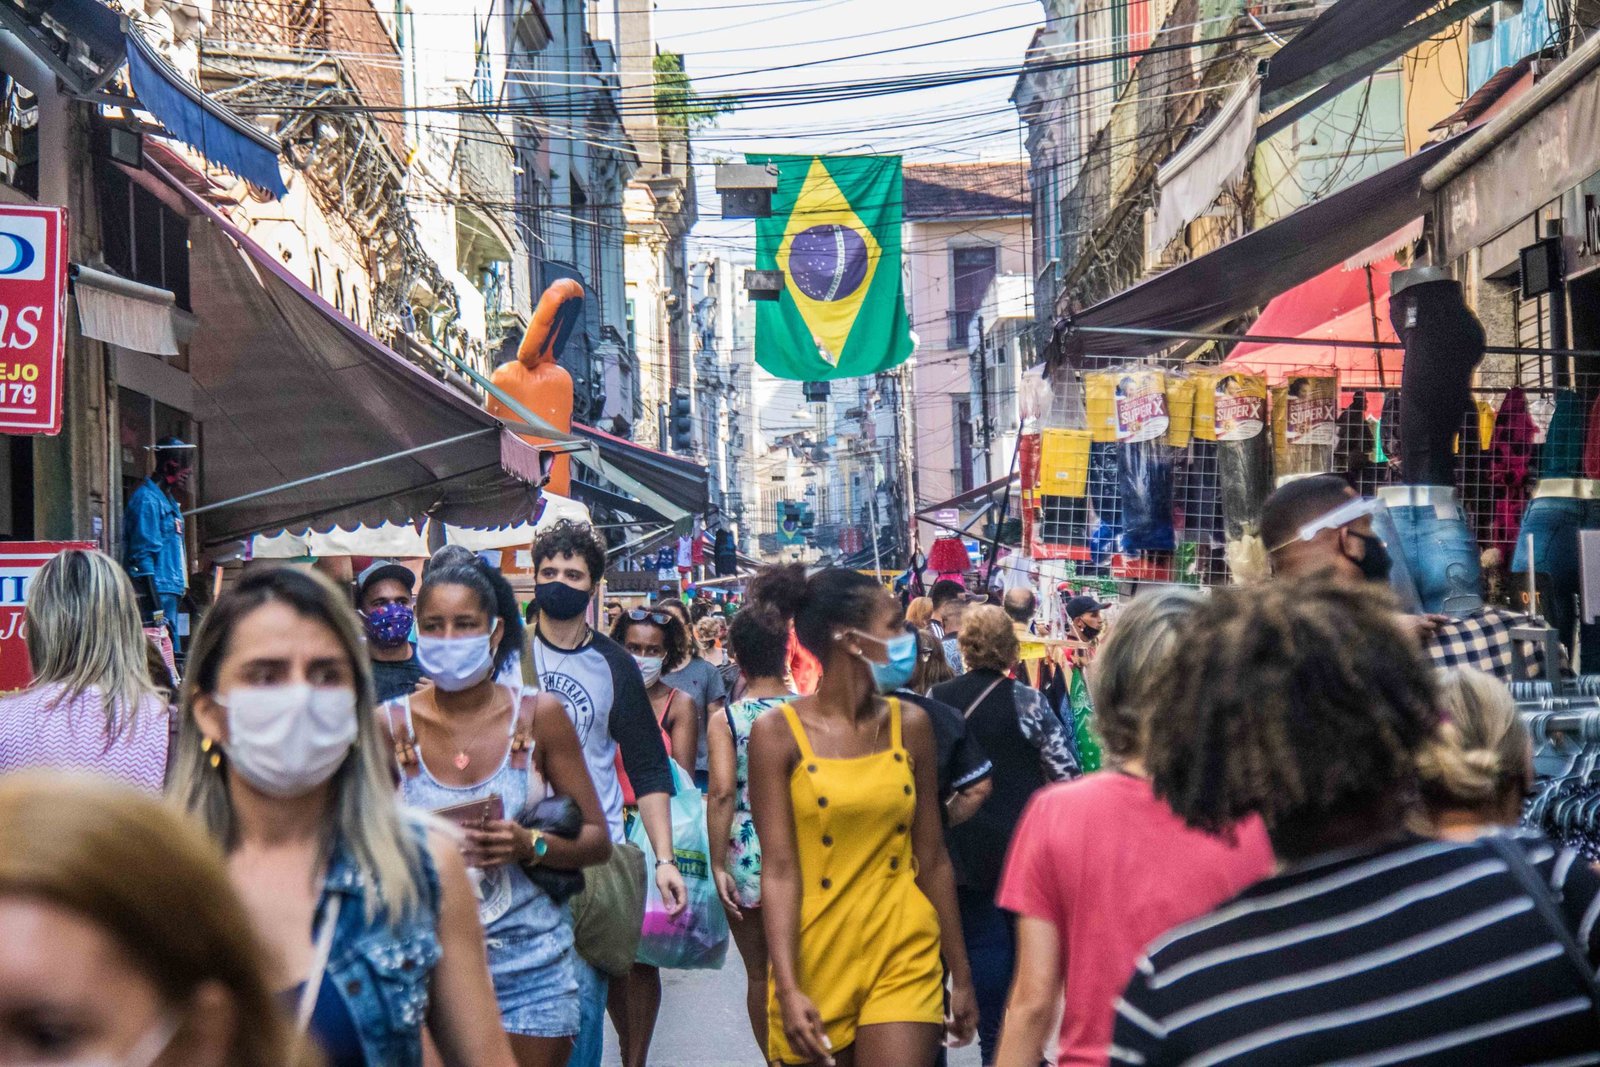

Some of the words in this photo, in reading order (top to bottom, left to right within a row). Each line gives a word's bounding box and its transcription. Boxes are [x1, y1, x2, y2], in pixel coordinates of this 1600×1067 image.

[1120, 402, 1152, 424] SUPER
[1152, 399, 1164, 415] X
[1216, 404, 1249, 421] SUPER
[1249, 403, 1261, 419] X
[1290, 407, 1323, 425] SUPER
[1324, 405, 1334, 420] X
[543, 674, 588, 707] SHEERAN
